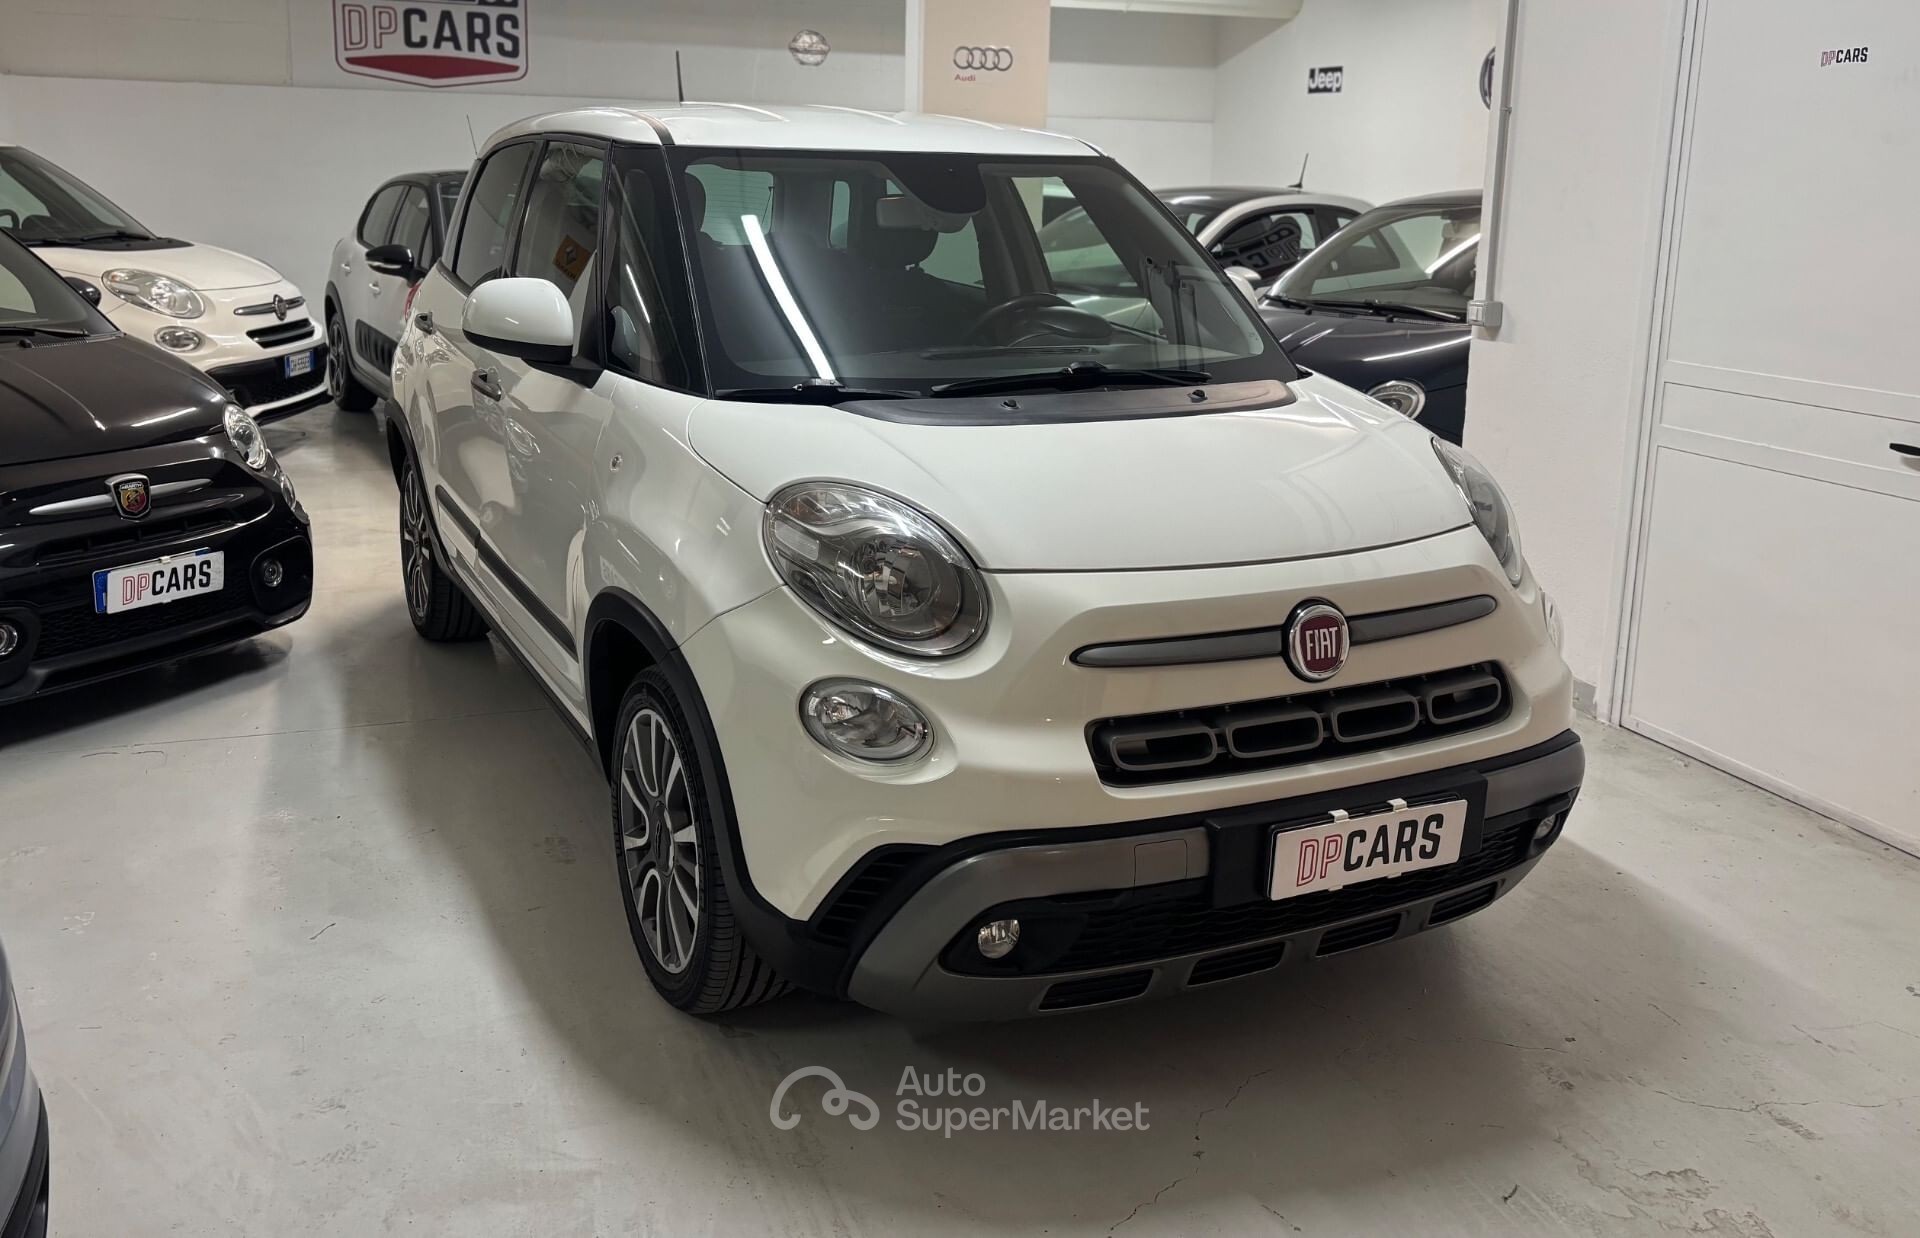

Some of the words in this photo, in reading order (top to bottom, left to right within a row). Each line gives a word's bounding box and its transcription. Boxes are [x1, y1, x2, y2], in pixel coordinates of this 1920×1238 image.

[342, 4, 520, 58] DPCARS
[1821, 47, 1868, 67] DPCARS
[954, 74, 976, 82] Audi
[1309, 69, 1342, 92] Jeep
[122, 560, 211, 605] DPCARS
[1305, 627, 1338, 660] FIAT
[1296, 813, 1444, 887] DPCARS
